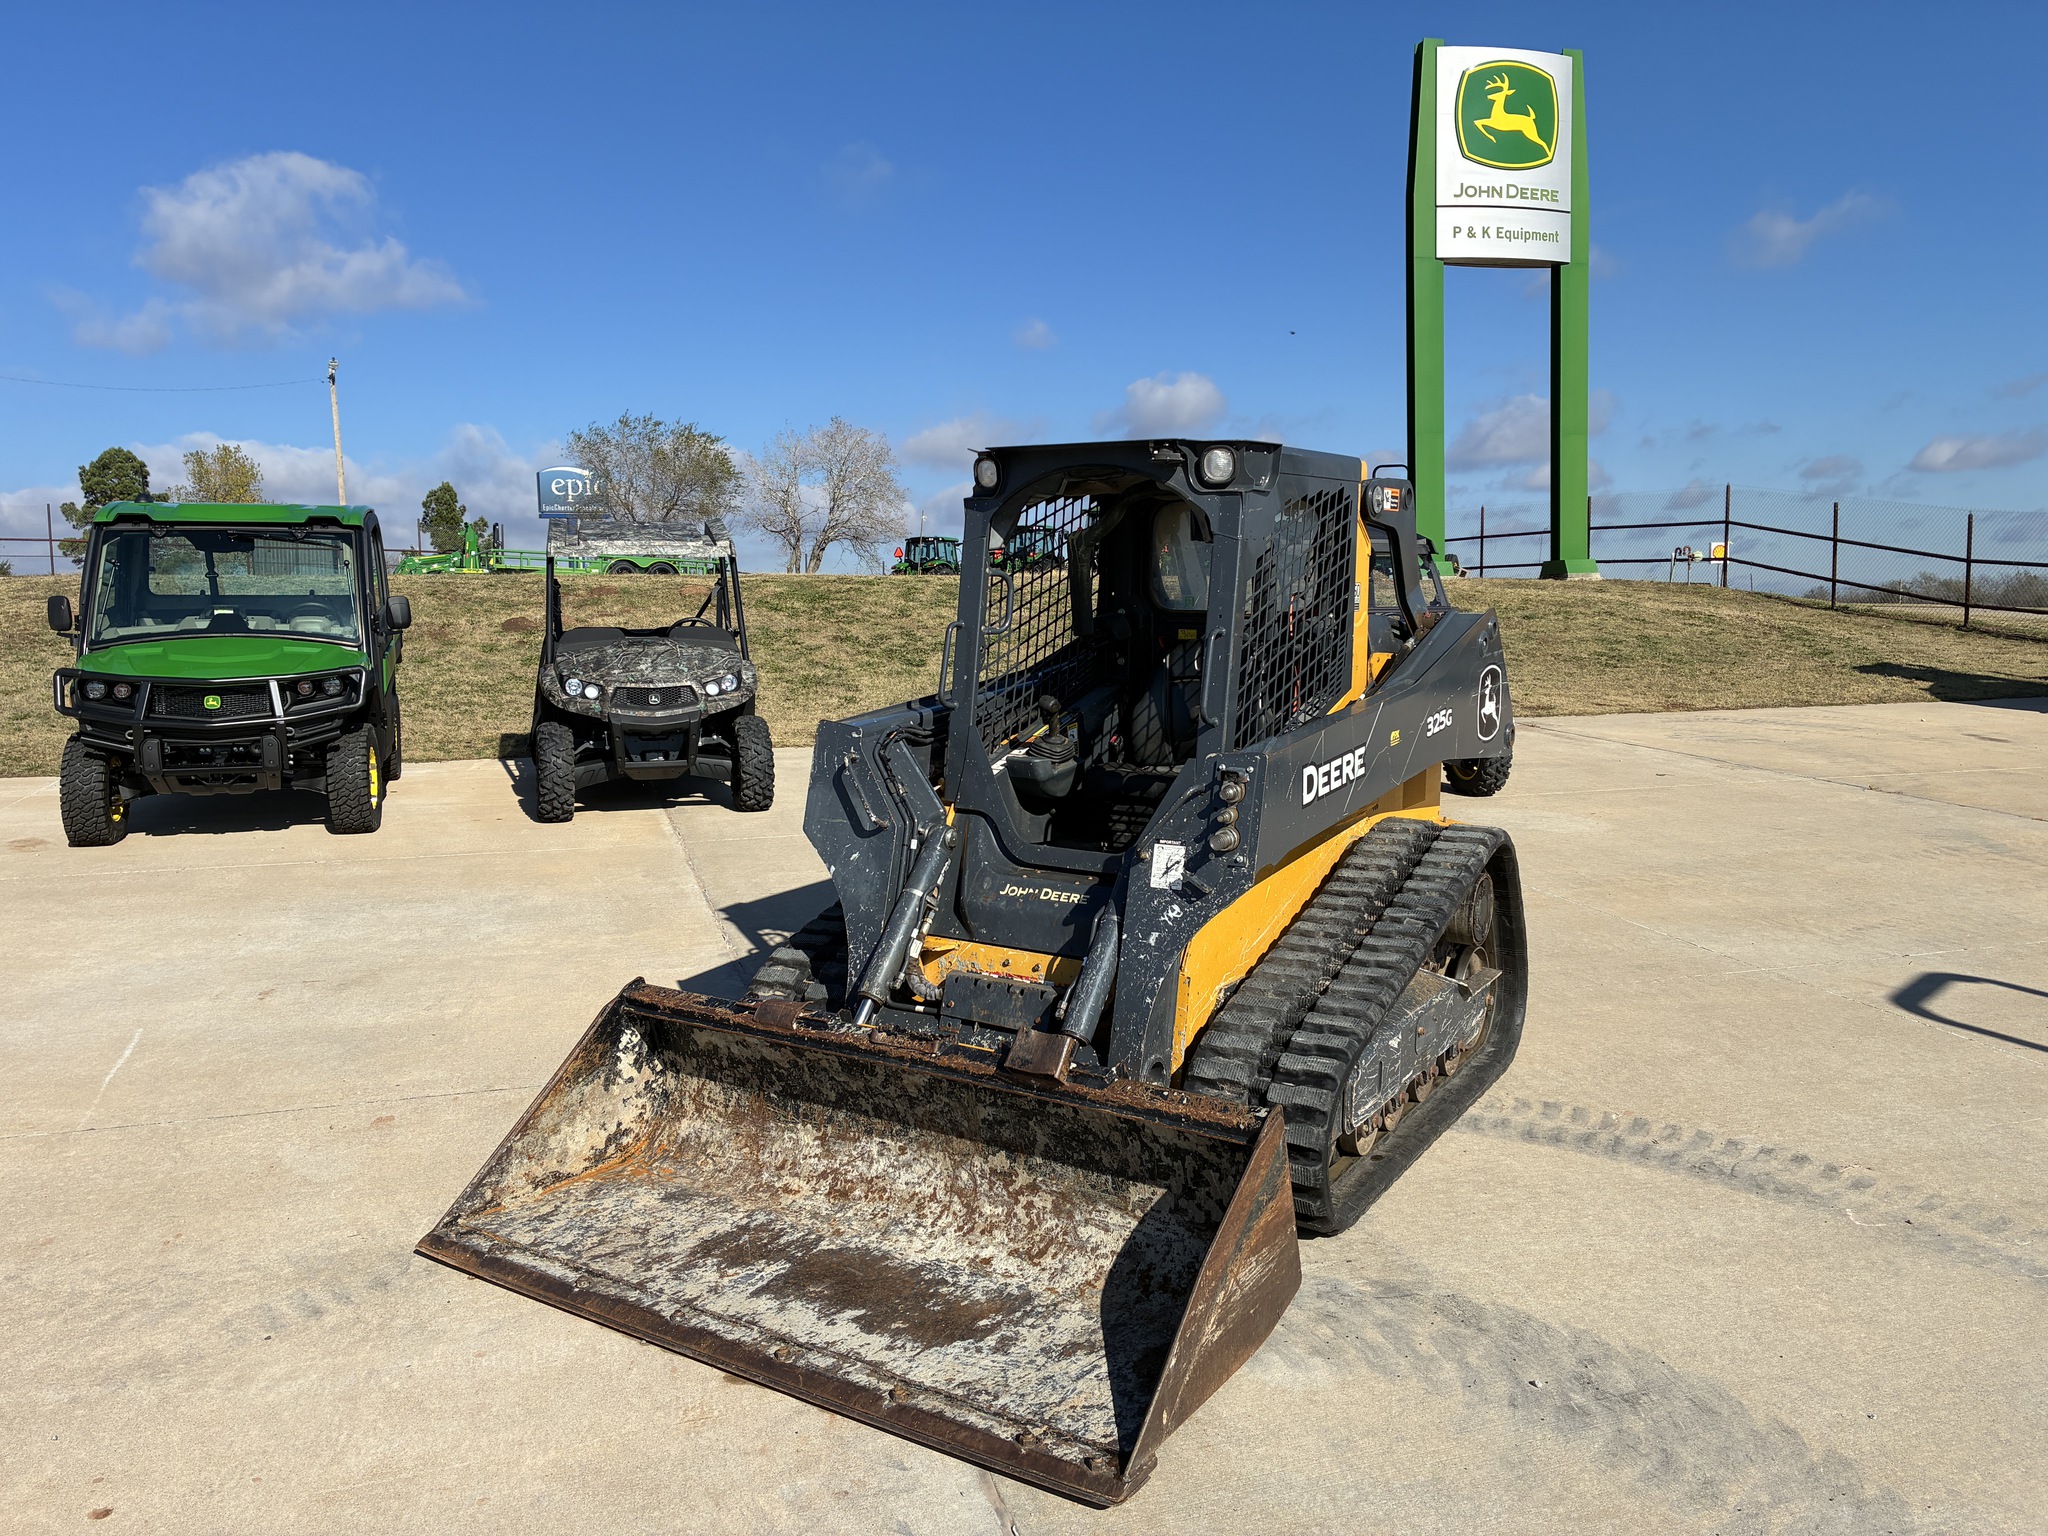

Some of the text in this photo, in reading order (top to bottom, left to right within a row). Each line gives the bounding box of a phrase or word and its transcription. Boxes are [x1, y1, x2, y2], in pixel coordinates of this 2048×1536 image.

[1453, 182, 1559, 203] JOHN DEERE
[1453, 226, 1559, 243] P & K Equipment
[551, 476, 605, 502] epic
[1426, 709, 1453, 738] 325G
[1302, 746, 1366, 806] DEERE
[1039, 888, 1090, 905] DEERE
